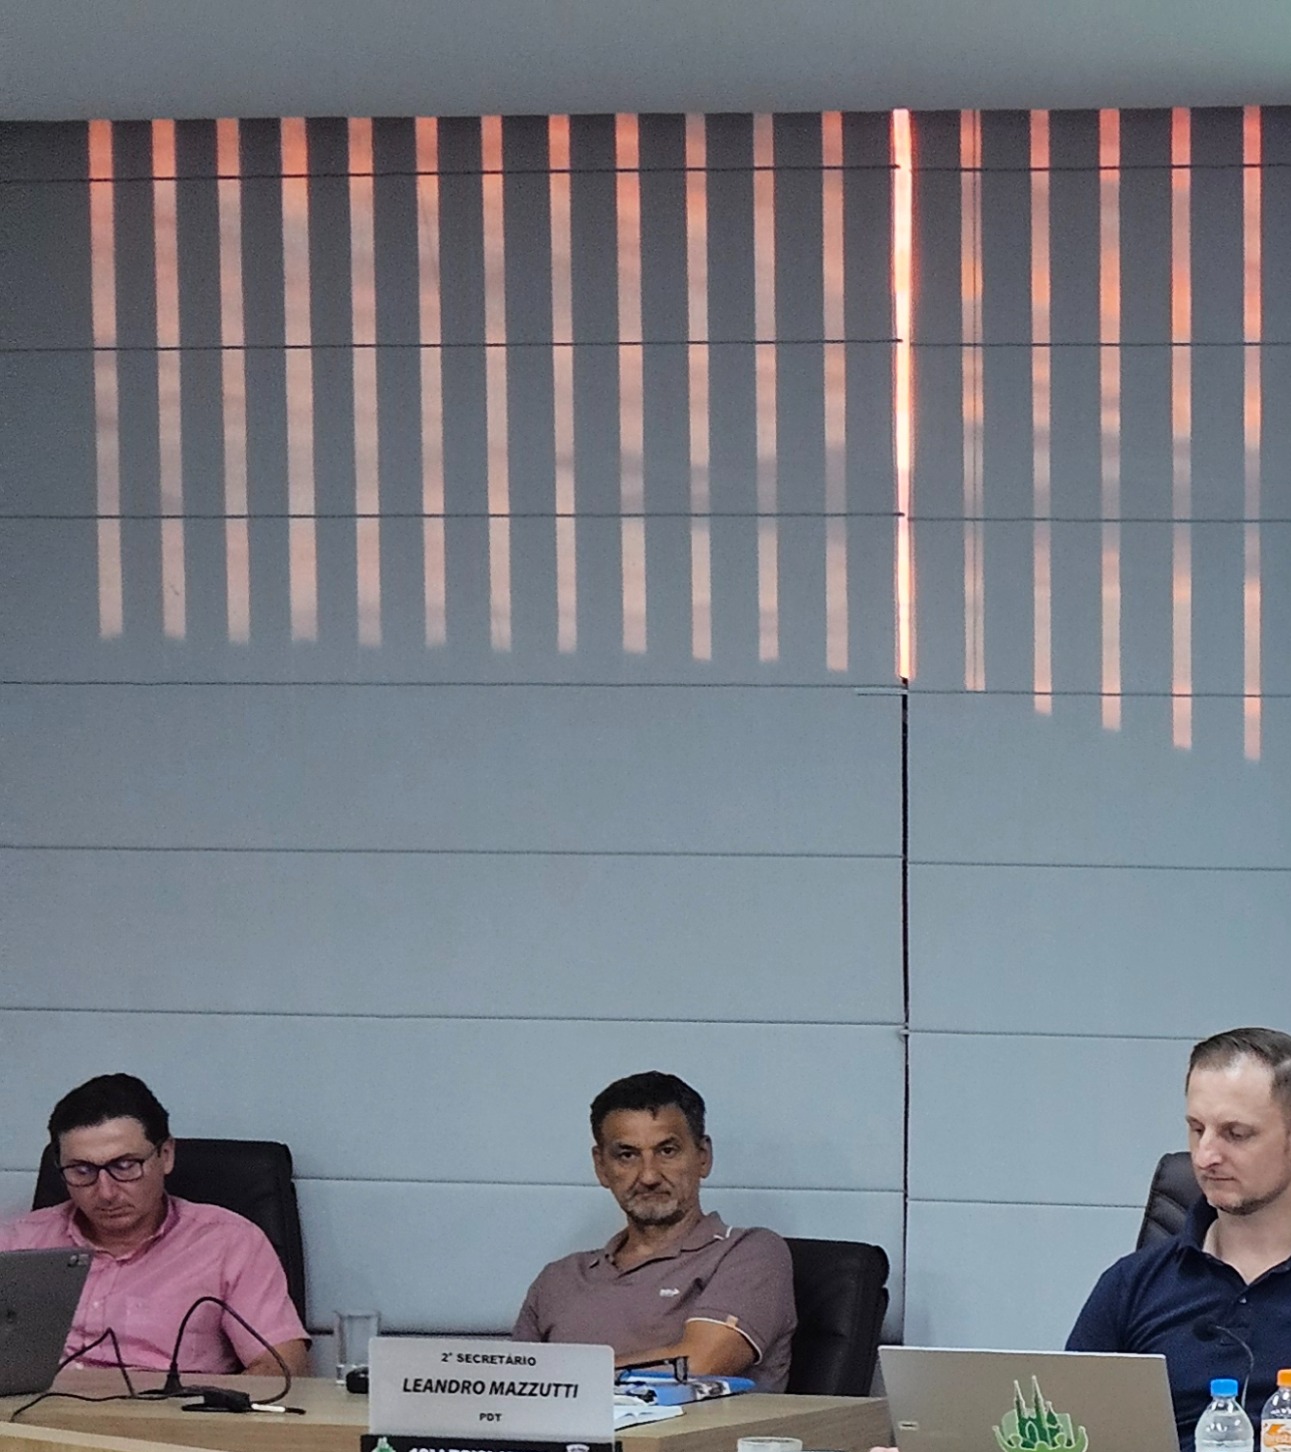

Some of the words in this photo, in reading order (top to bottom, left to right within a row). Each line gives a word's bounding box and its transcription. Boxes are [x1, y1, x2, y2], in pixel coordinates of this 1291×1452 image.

[457, 1354, 536, 1366] SECRETÁRIO
[403, 1378, 485, 1395] LEANDRO
[490, 1381, 578, 1398] MAZZUTTI
[479, 1413, 502, 1421] PDT
